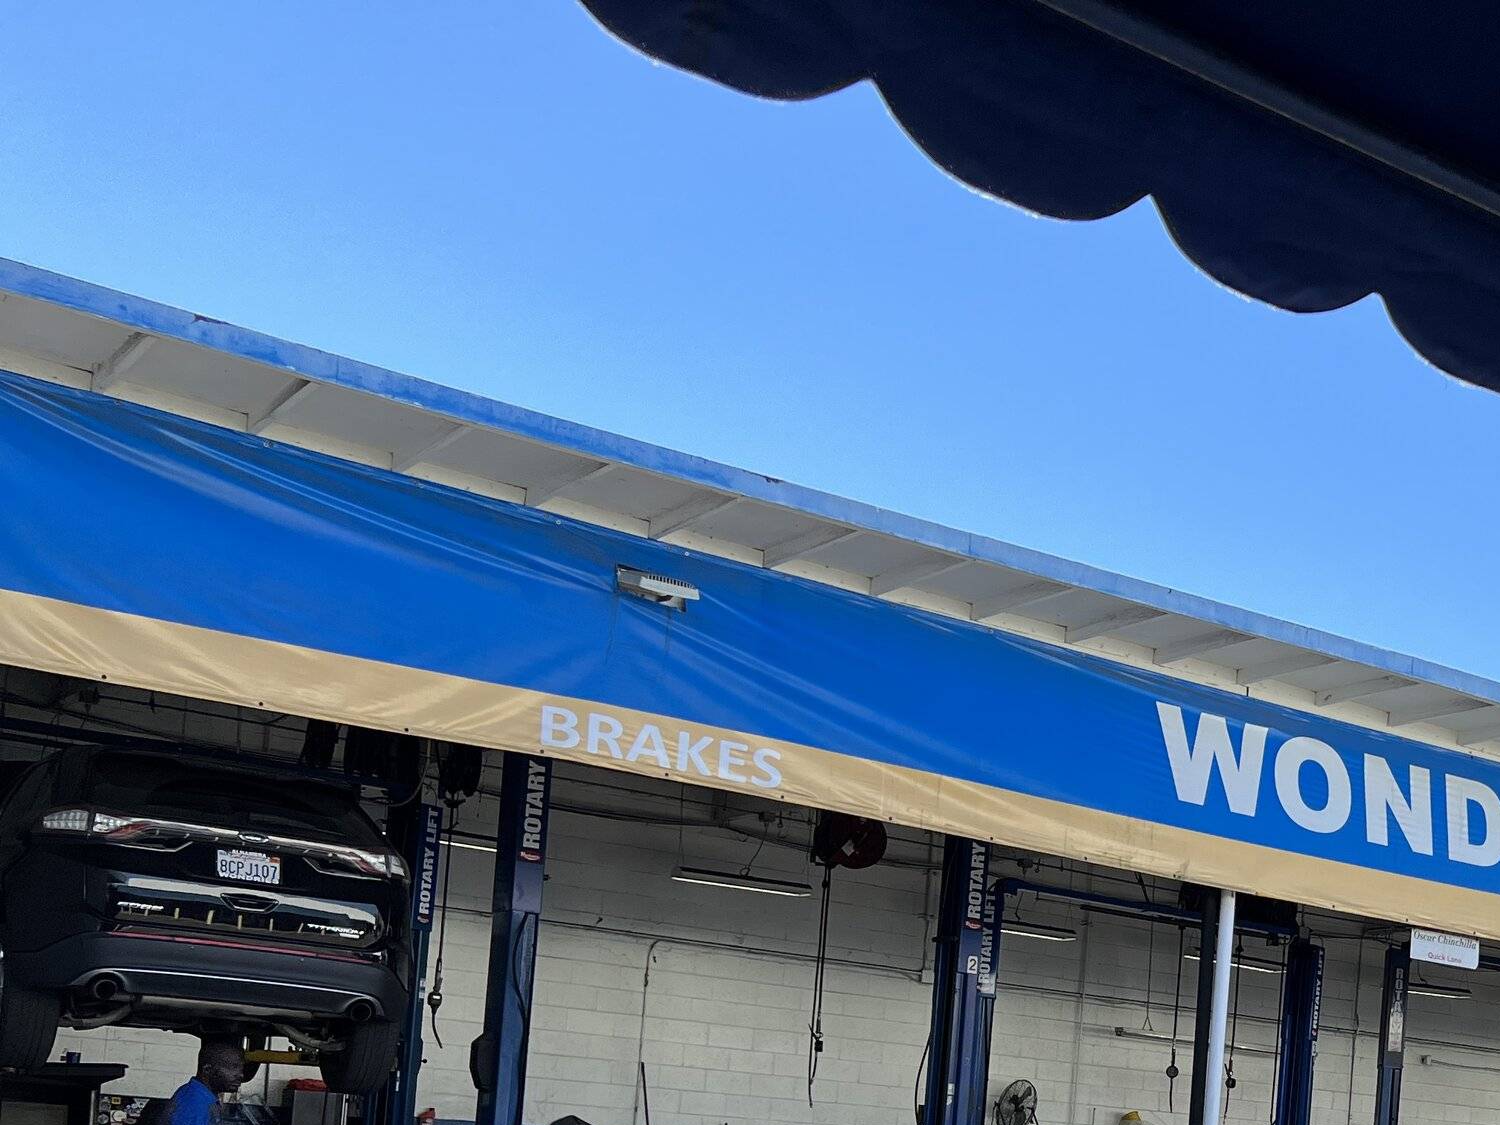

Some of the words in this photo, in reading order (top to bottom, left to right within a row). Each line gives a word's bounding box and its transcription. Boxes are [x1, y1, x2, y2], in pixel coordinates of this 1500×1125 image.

[540, 705, 782, 788] BRAKES
[426, 808, 439, 843] LIFT
[523, 760, 546, 849] ROTARY
[220, 859, 278, 880] 8CPJ107
[419, 848, 435, 914] ROTARY
[967, 841, 986, 919] ROTARY
[968, 958, 977, 971] 2
[978, 927, 993, 984] ROTARY
[1437, 934, 1477, 950] Chinchilla
